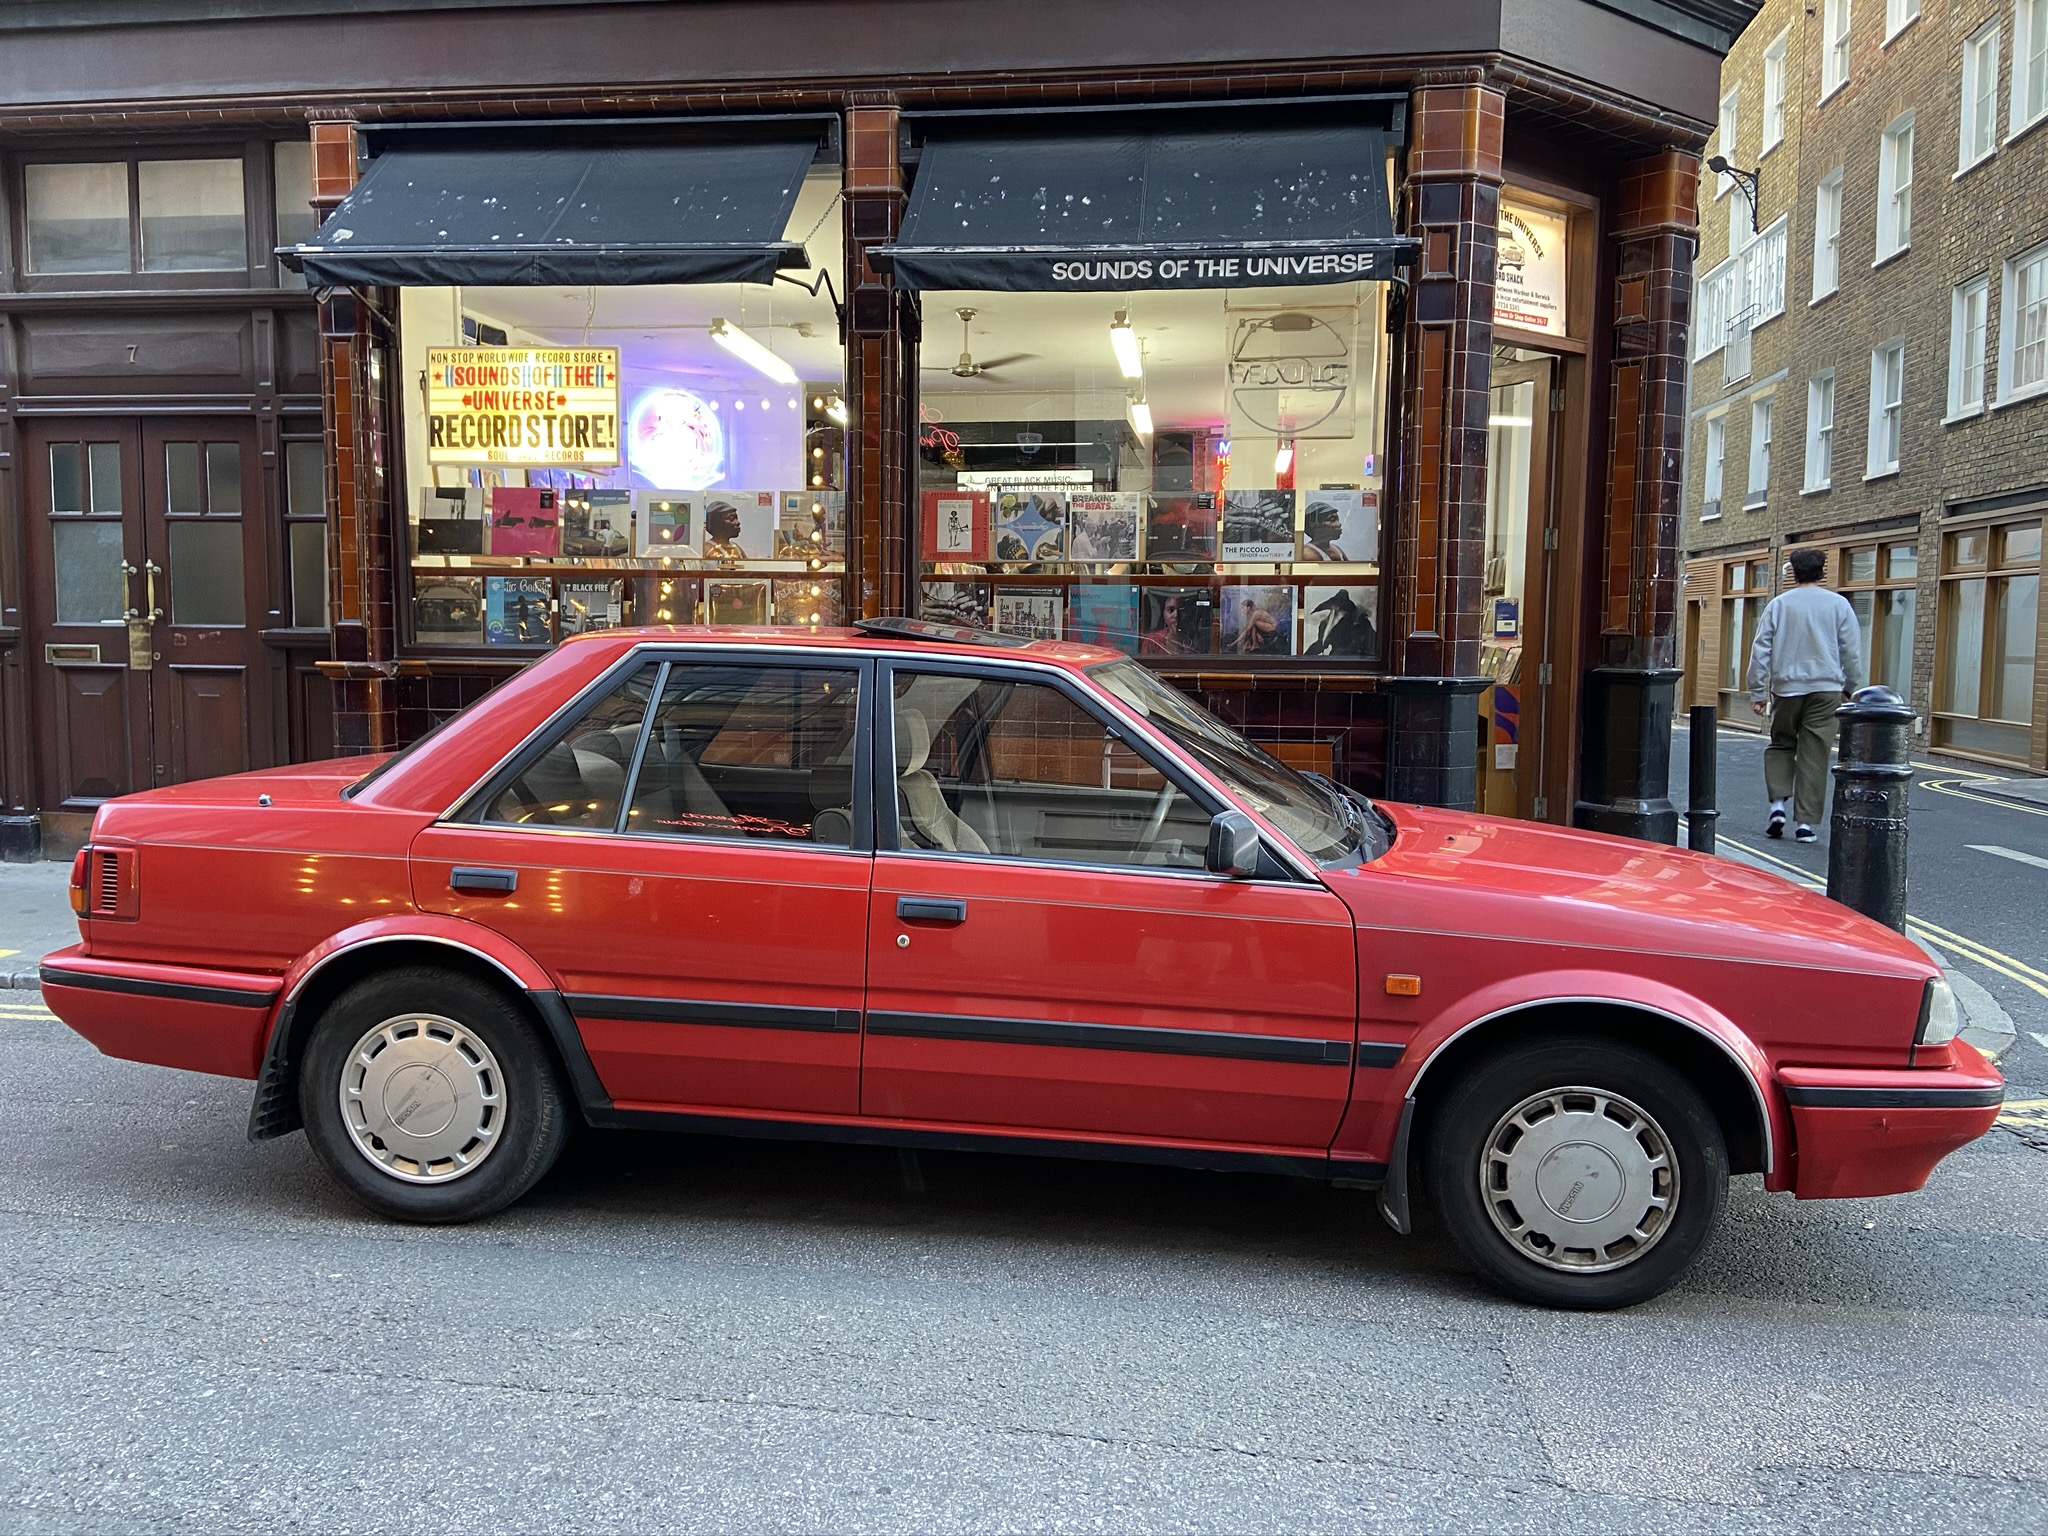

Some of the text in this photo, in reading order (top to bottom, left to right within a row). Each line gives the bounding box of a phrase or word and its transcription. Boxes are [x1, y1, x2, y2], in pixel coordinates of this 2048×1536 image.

[1500, 209, 1545, 260] THE UNIVERSE
[1052, 253, 1374, 281] SOUNDS OF THE UNIVERSE
[1506, 273, 1524, 285] SHACK
[1513, 288, 1530, 297] Wardour
[1535, 292, 1550, 301] Berwick
[126, 344, 139, 364] 7
[431, 352, 603, 363] NON STOP WORLDWIDE RECORD STORE
[454, 366, 595, 386] SOUNDS OF THE
[473, 390, 556, 411] UNIVERSE
[487, 450, 509, 461] SOUL
[985, 476, 1013, 484] GREAT
[1014, 476, 1042, 484] BLACK
[1054, 484, 1087, 492] FUTURE
[1072, 494, 1117, 502] BREAKING
[572, 584, 609, 592] BLACK FIRE
[1558, 1181, 1584, 1214] NISSAN
